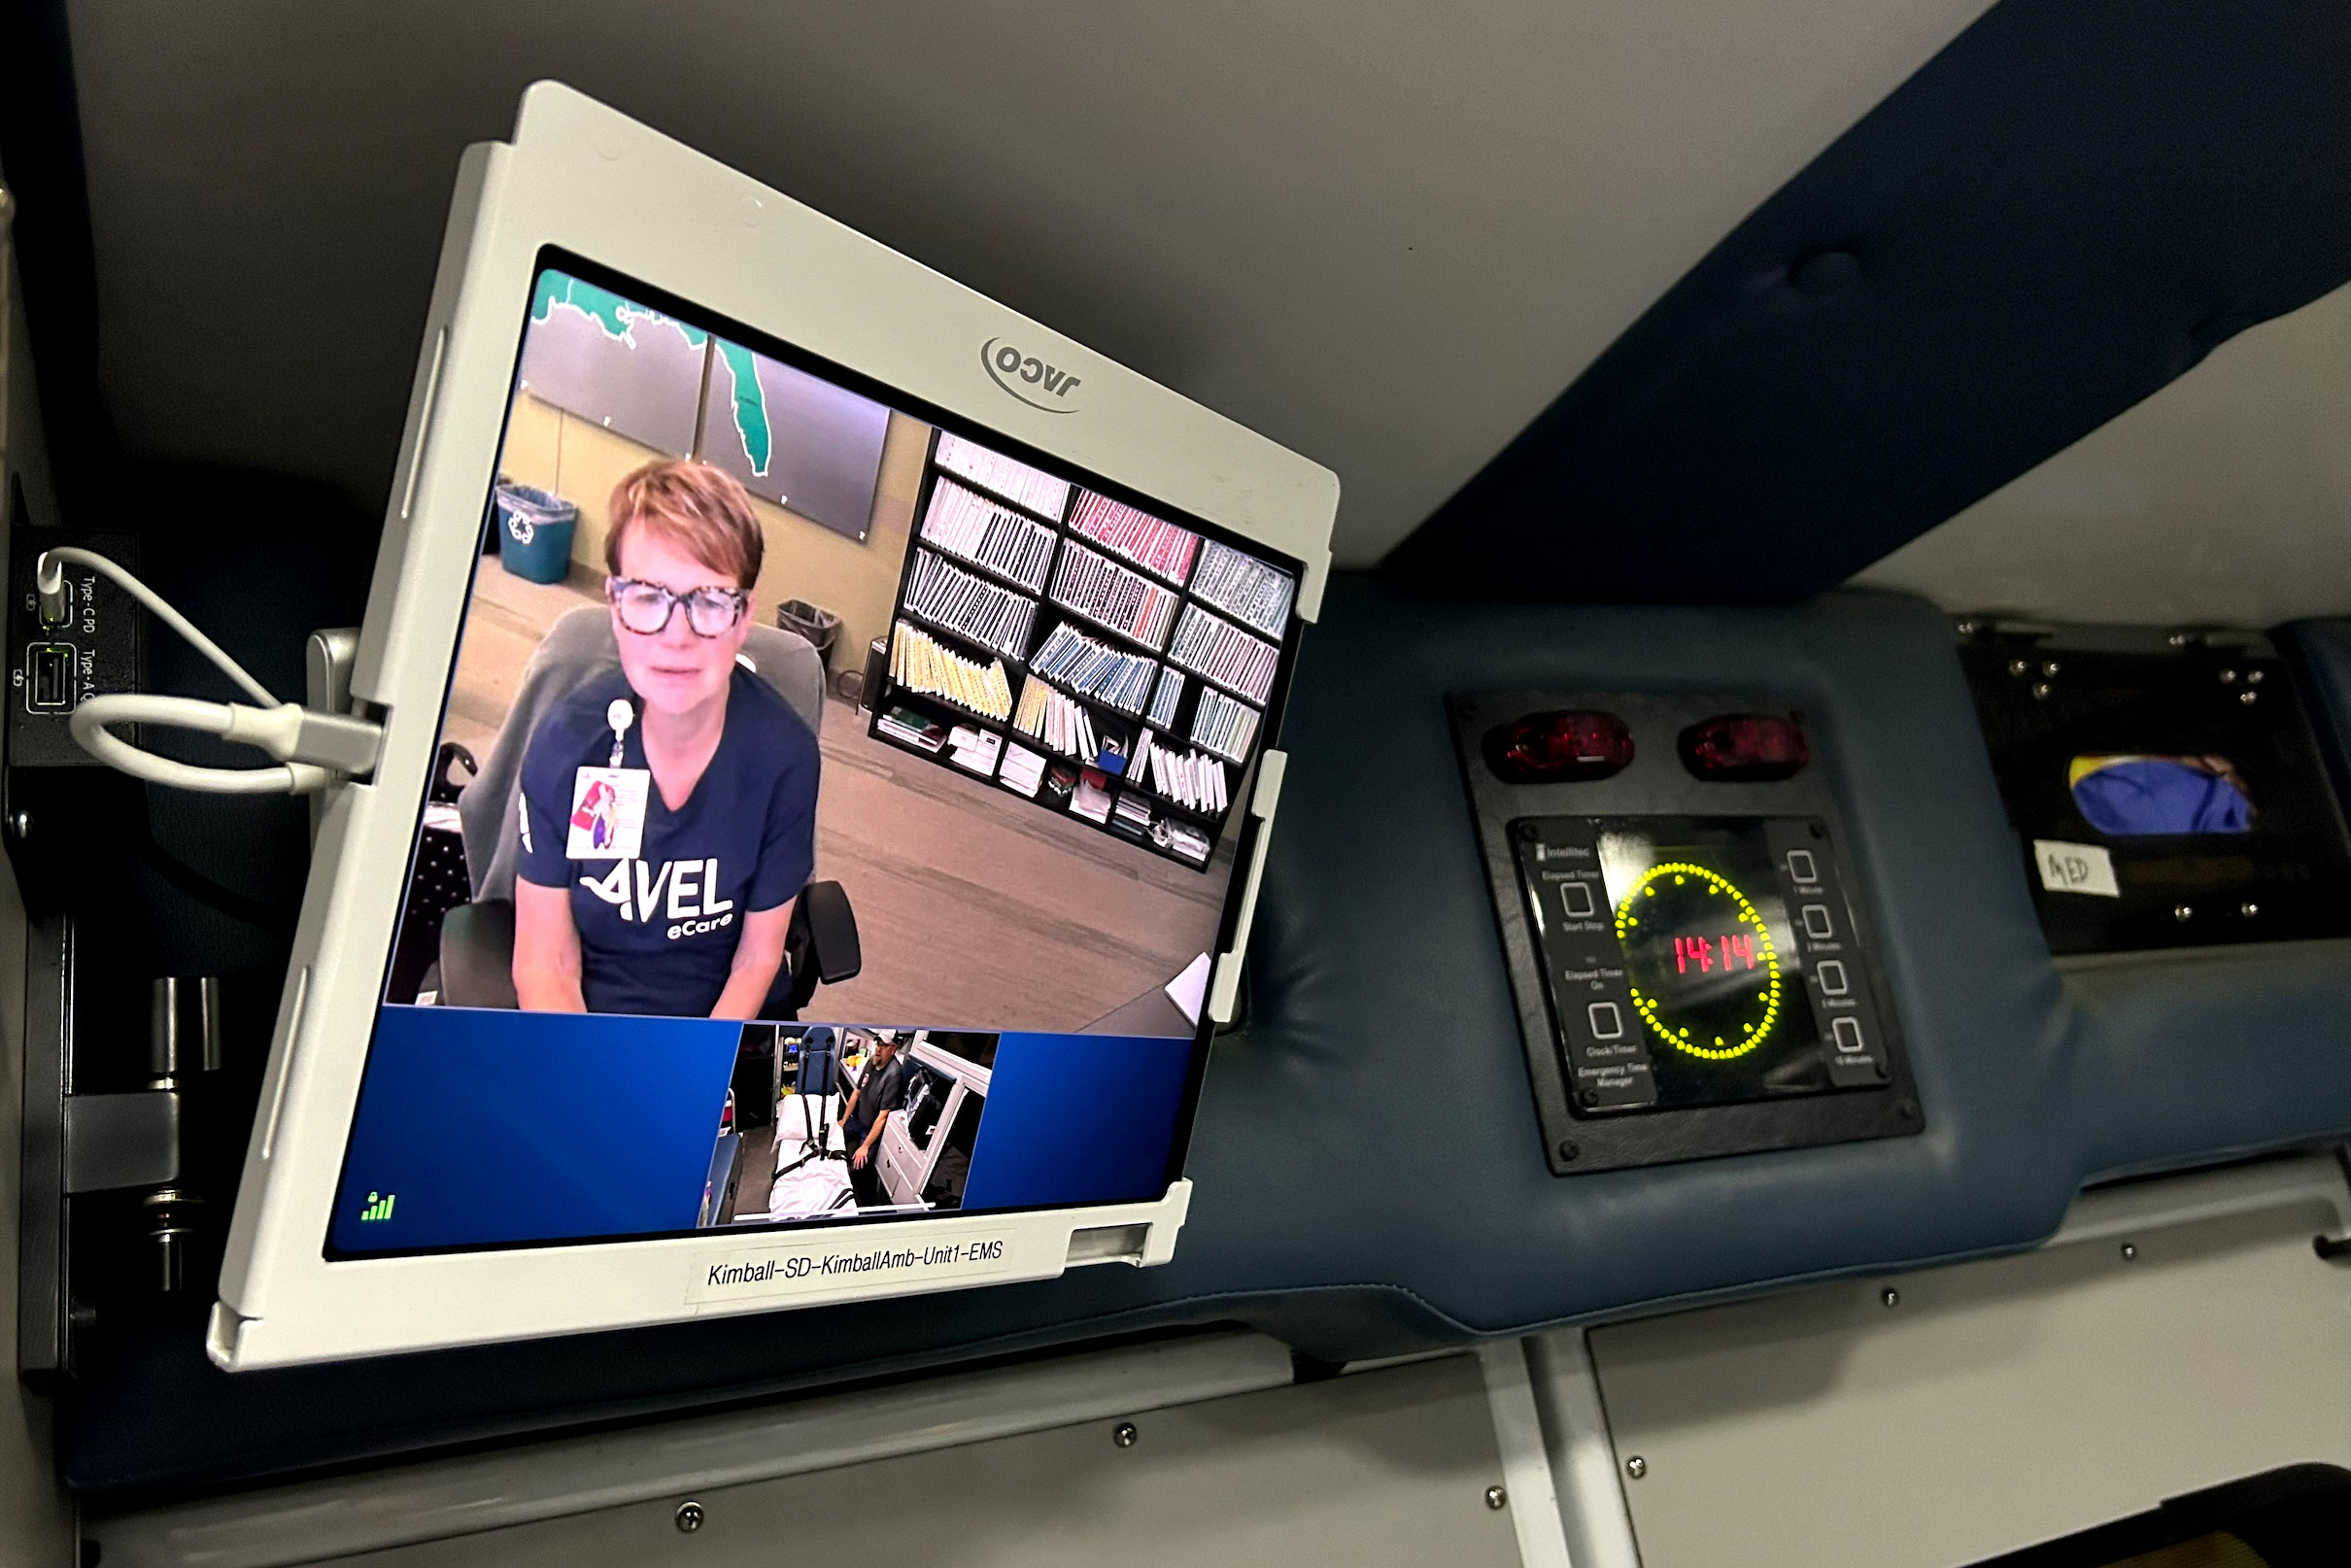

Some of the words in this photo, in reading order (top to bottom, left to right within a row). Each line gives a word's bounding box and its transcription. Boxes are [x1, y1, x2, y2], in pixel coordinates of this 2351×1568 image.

[995, 346, 1081, 397] JACO
[80, 576, 95, 617] Type-C
[83, 618, 95, 633] PD
[80, 649, 95, 690] Type-A
[579, 858, 733, 923] AVEL
[666, 913, 733, 940] eCare
[1674, 934, 1755, 974] 14:14
[707, 1240, 1004, 1286] Kimball-SD-KimballAmb-Unit1-EMS
